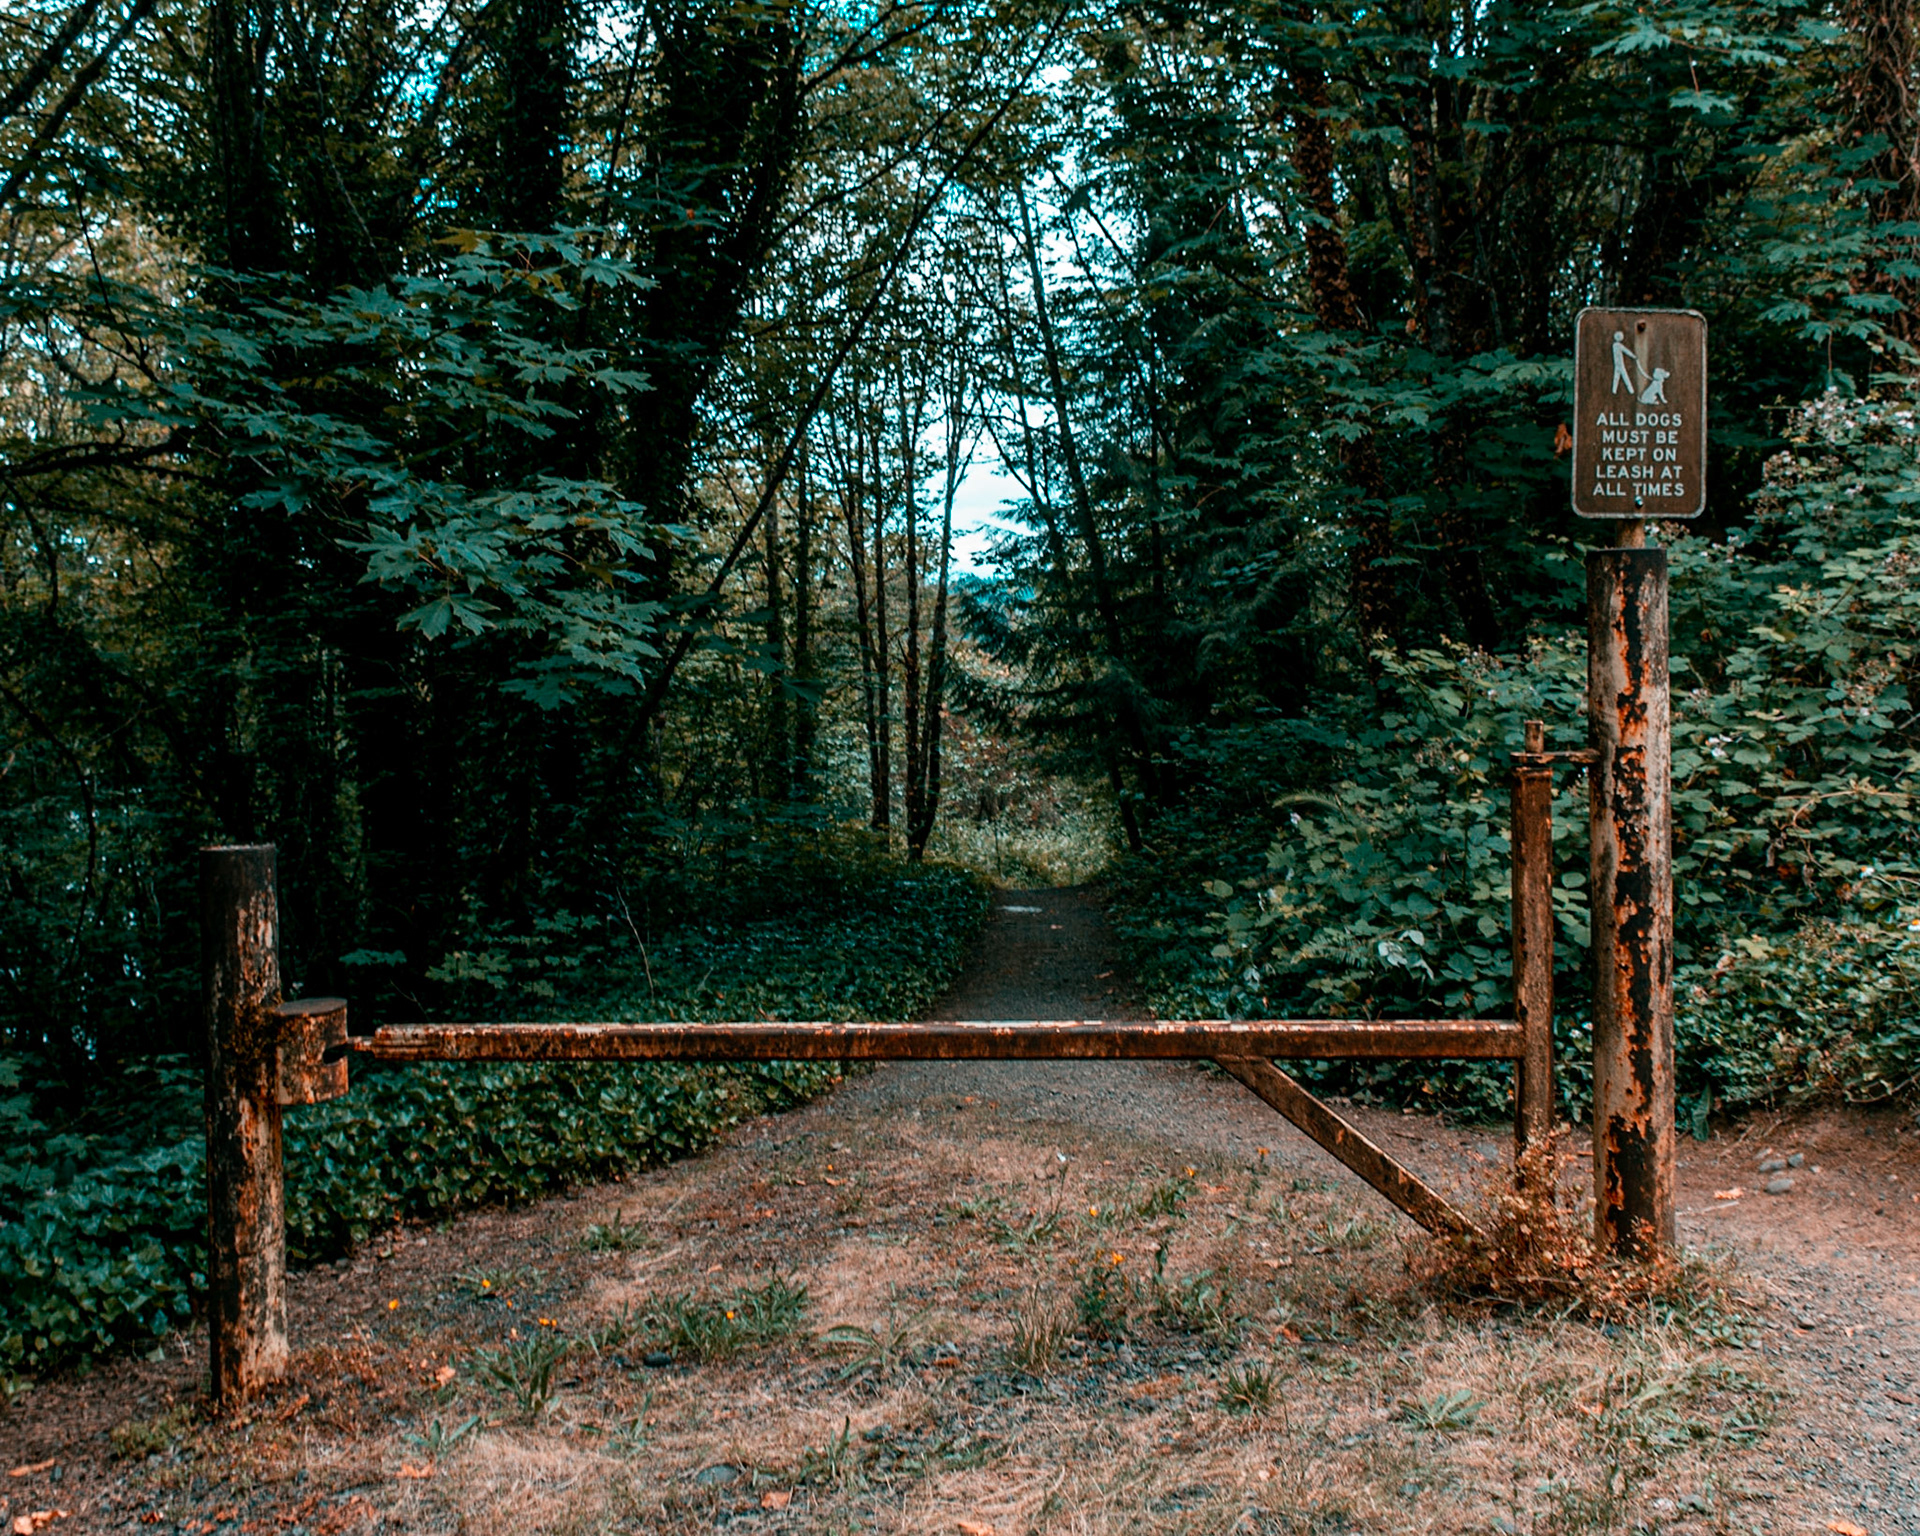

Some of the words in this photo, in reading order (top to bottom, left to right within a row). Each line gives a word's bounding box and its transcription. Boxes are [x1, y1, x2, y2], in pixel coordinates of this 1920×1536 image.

[1596, 412, 1629, 426] ALL
[1636, 412, 1682, 427] DOGS
[1602, 430, 1649, 444] MUST
[1656, 430, 1678, 444] BE
[1602, 447, 1647, 461] KEPT
[1653, 447, 1676, 461] ON
[1596, 465, 1654, 479] LEASH
[1660, 465, 1683, 479] AT
[1593, 483, 1626, 496] ALL
[1632, 483, 1685, 497] TIMES
